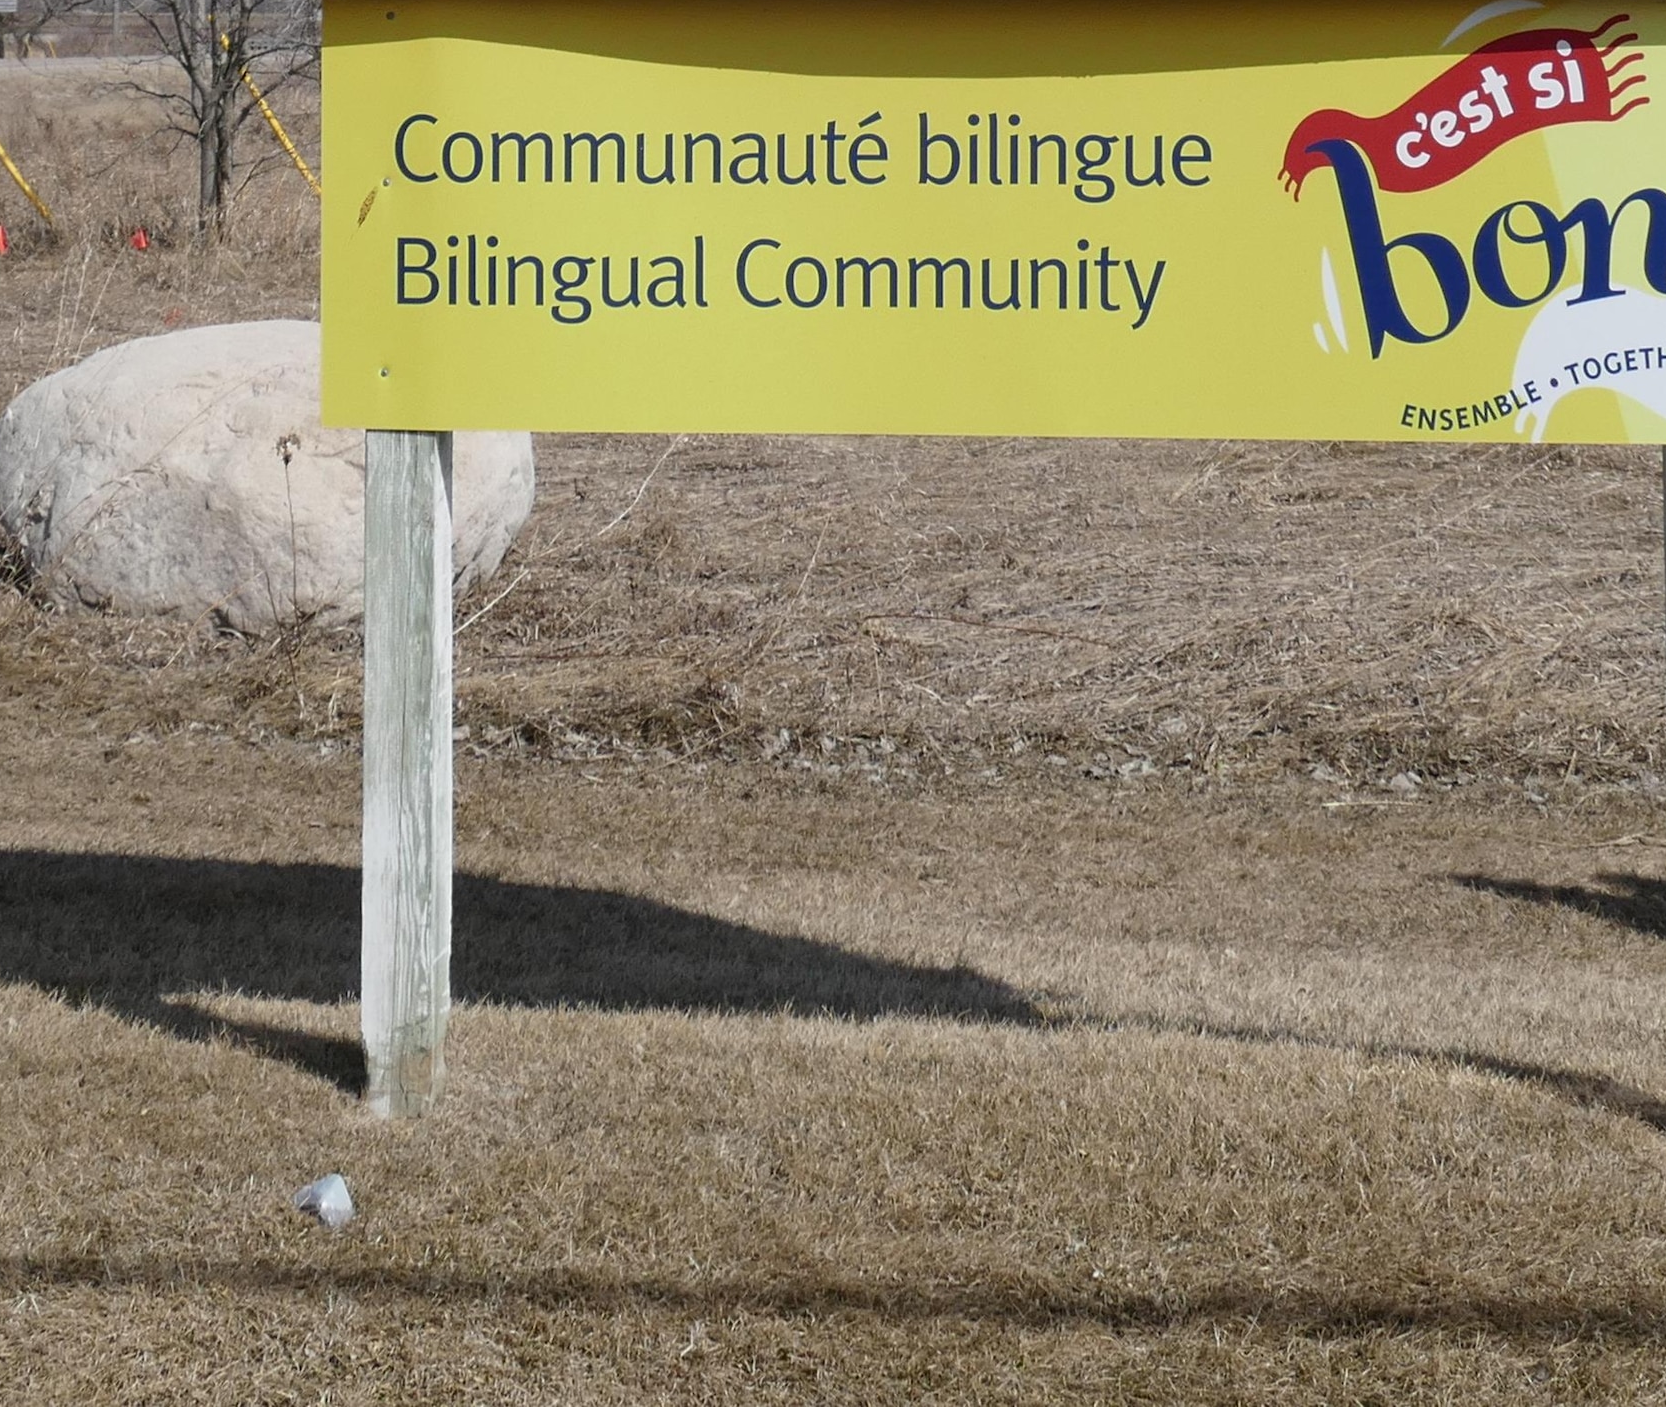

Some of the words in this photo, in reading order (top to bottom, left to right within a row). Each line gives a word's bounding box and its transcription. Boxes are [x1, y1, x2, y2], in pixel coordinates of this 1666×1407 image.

[1395, 65, 1515, 169] c'est
[1527, 39, 1587, 110] si
[394, 110, 889, 186] Communauté
[917, 111, 1213, 204] bilingue
[396, 233, 709, 325] Bilingual
[735, 237, 1167, 331] Community
[1400, 380, 1543, 432] ENSEMBLE
